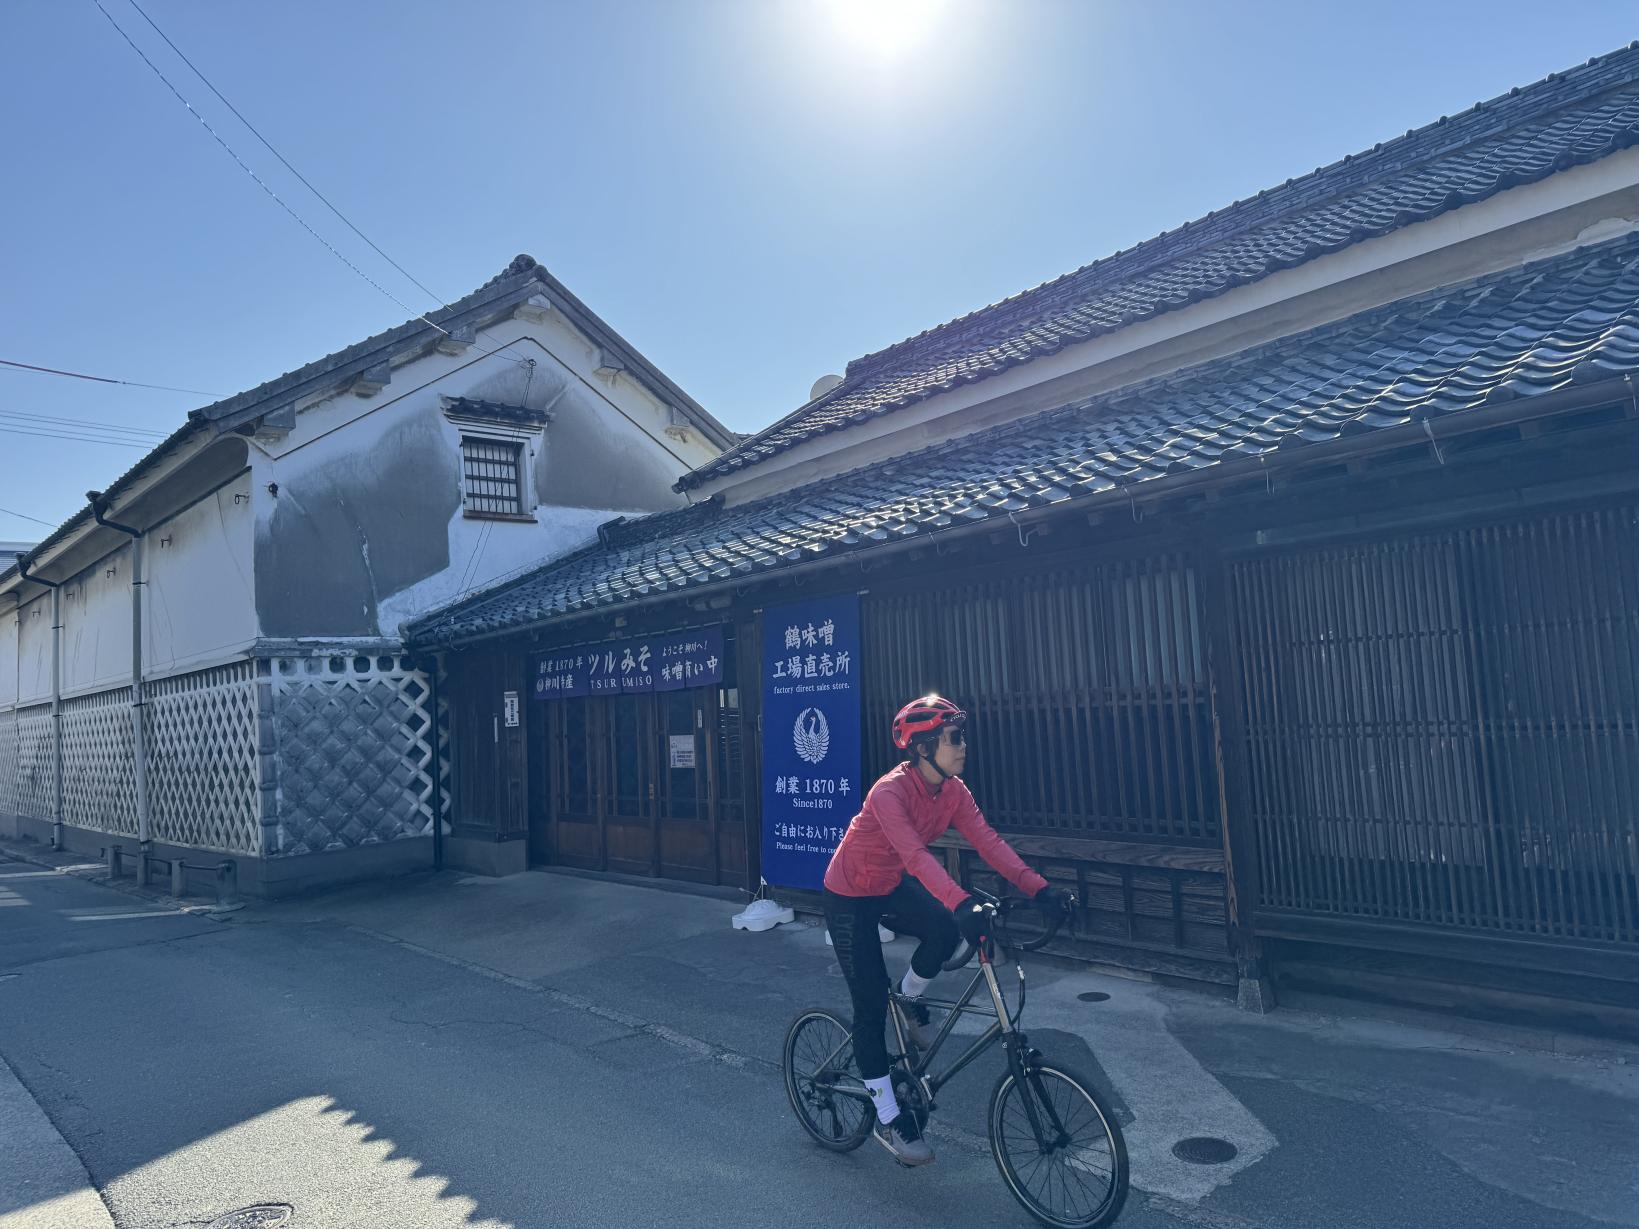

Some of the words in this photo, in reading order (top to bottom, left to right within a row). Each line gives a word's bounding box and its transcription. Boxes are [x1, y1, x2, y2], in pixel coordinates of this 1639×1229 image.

[785, 619, 834, 650] 鶴味噌
[588, 645, 651, 675] ツルみそ
[773, 651, 850, 678] 工場直売所
[796, 684, 815, 692] direct
[817, 683, 830, 691] sales
[832, 682, 850, 690] store.
[793, 798, 833, 809] Since1870
[776, 842, 793, 850] Please
[795, 843, 806, 852] feel
